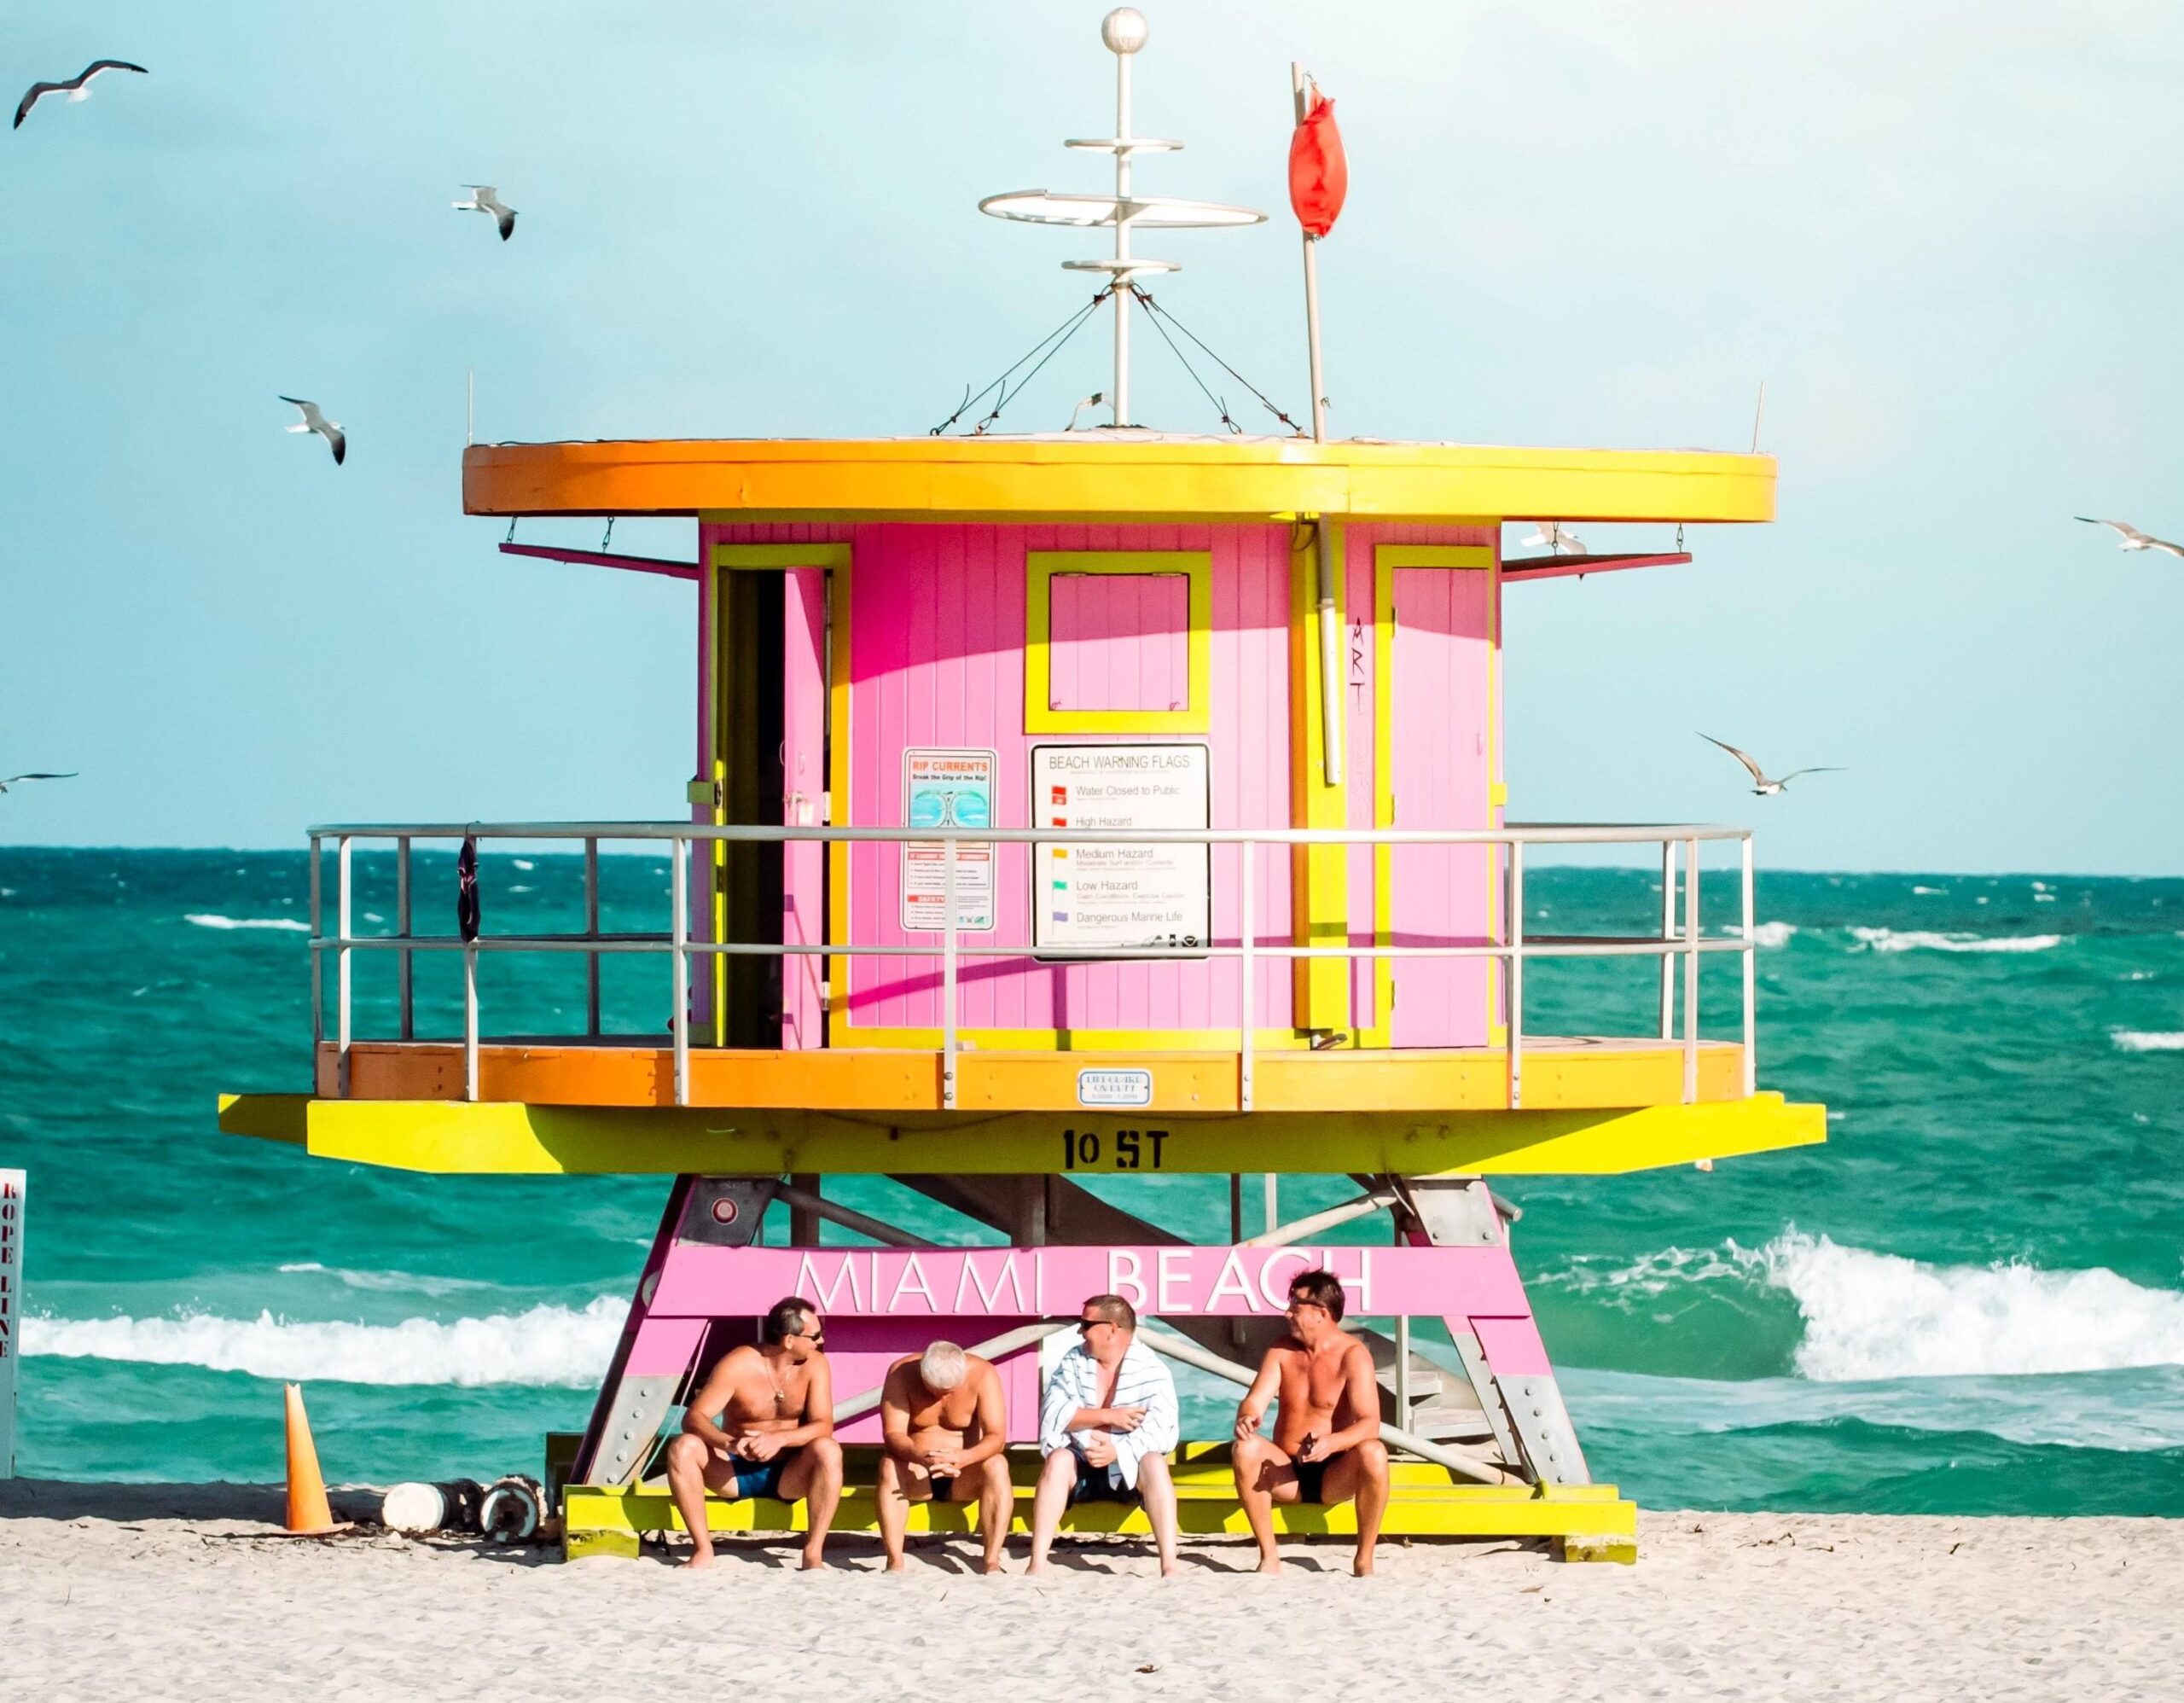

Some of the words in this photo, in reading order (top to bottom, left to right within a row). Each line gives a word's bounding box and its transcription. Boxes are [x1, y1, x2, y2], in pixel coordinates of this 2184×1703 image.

[1350, 616, 1365, 713] ART
[913, 761, 929, 770] RIP
[932, 761, 988, 772] CURRENTS
[1049, 756, 1089, 770] BEACH
[1093, 756, 1148, 769] WARNING
[1153, 755, 1190, 768] FLAGS
[1076, 786, 1103, 796] Water
[1106, 785, 1139, 796] Closed
[1141, 786, 1151, 795] to
[1153, 785, 1180, 795] Public
[1076, 817, 1095, 828] High
[1099, 817, 1132, 826] Hazard
[1076, 848, 1114, 858] Medium
[1118, 848, 1153, 858] Hazard
[1076, 881, 1097, 891] Low
[1101, 881, 1138, 890] Hazard
[1077, 912, 1128, 925] Dangerous
[1131, 911, 1163, 921] Marine
[1166, 911, 1182, 921] Life
[1063, 1129, 1100, 1170] 10
[1116, 1129, 1170, 1169] ST
[1, 1183, 17, 1264] ROPE
[793, 1250, 1044, 1315] MIAMI
[1108, 1248, 1371, 1314] BEACH
